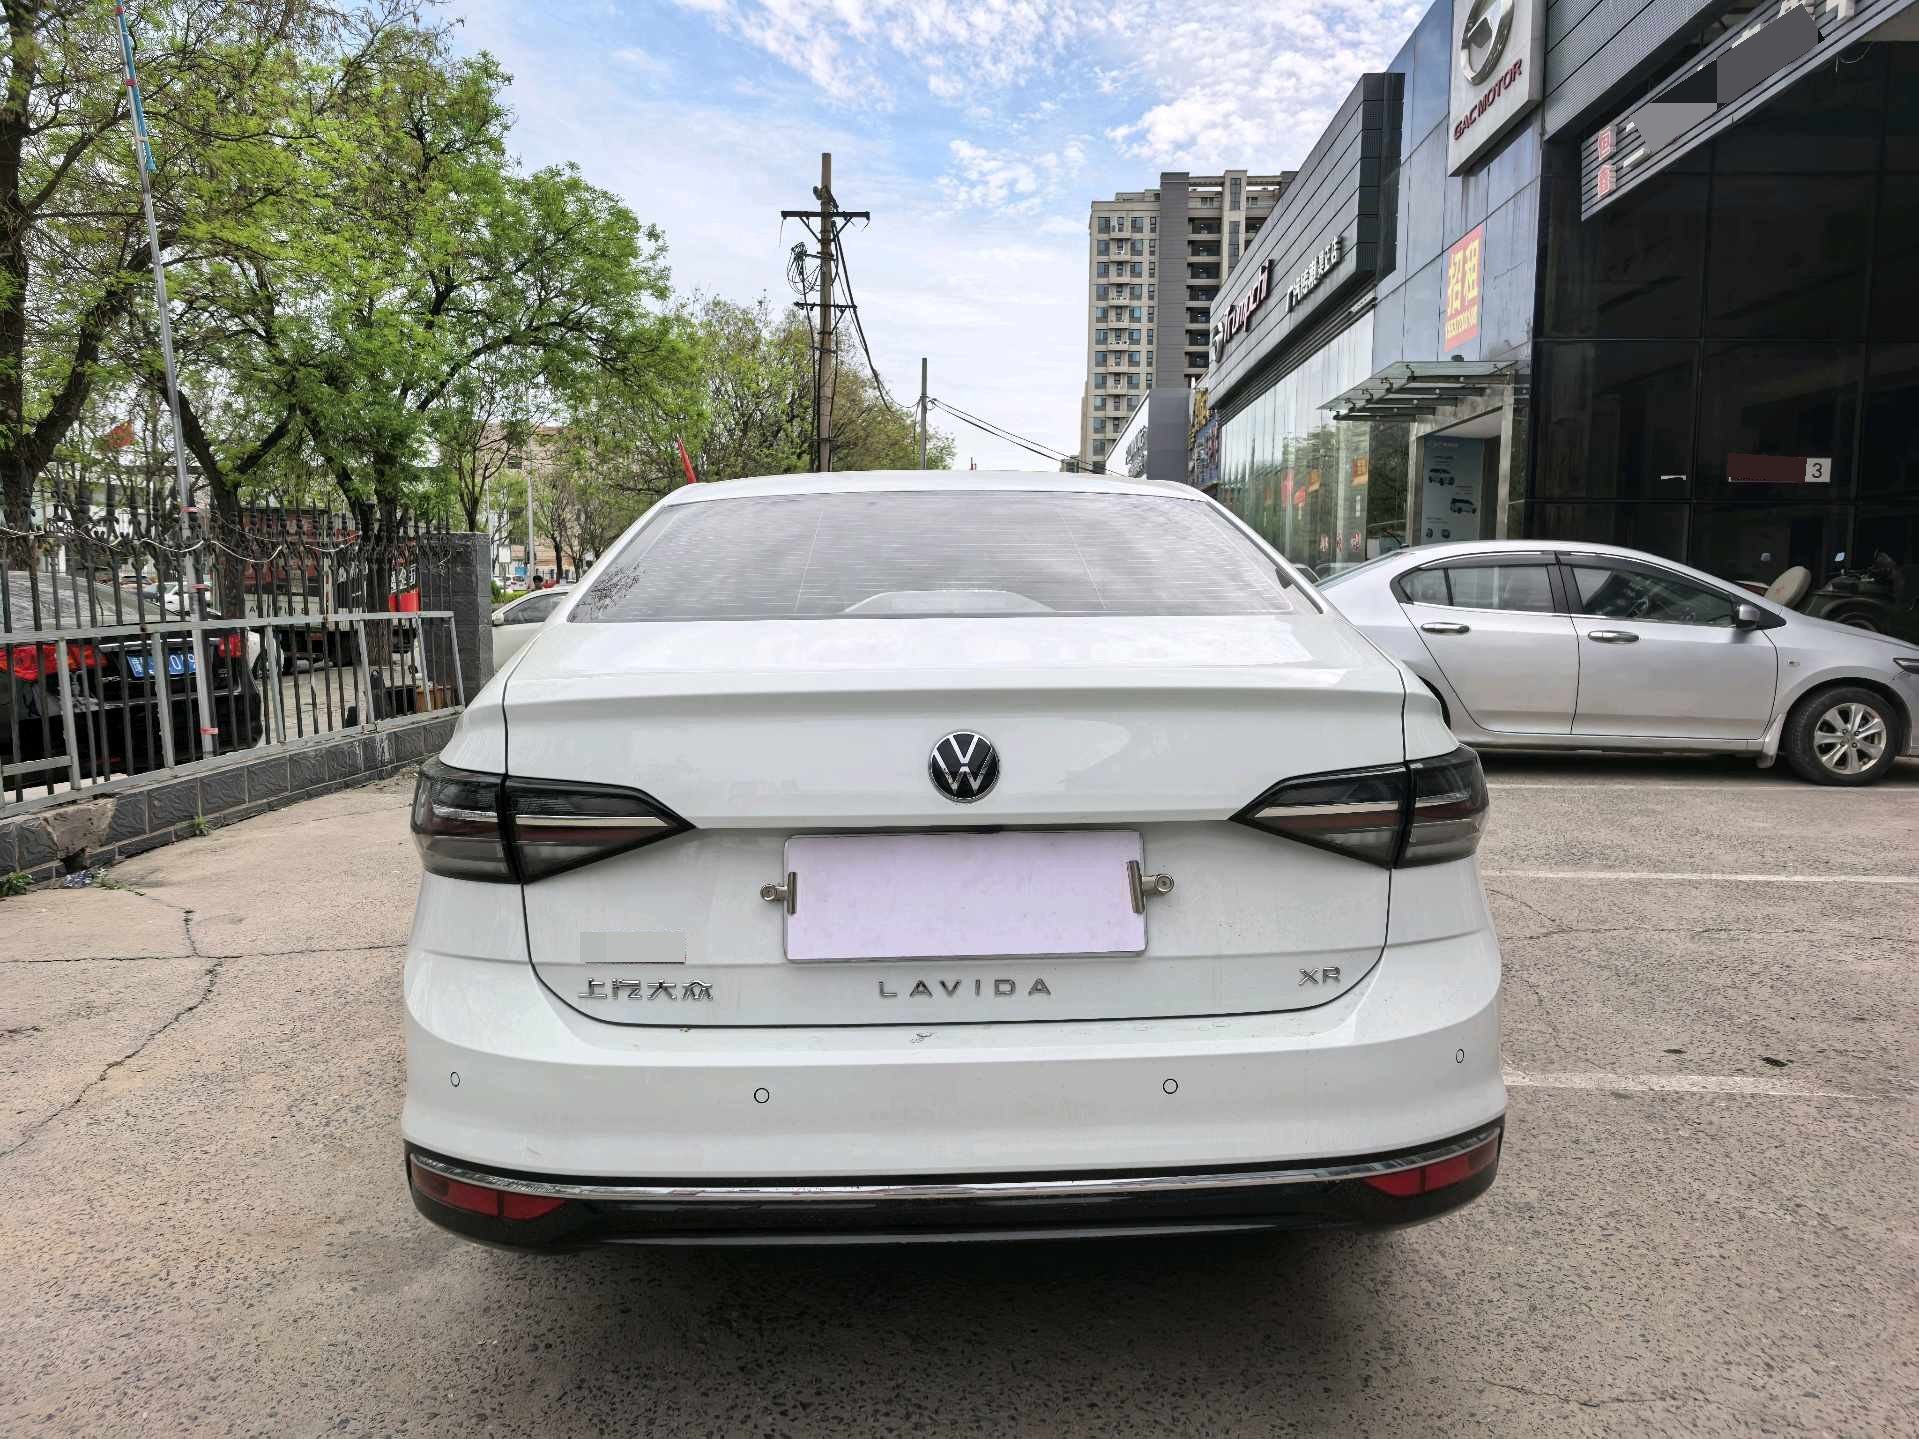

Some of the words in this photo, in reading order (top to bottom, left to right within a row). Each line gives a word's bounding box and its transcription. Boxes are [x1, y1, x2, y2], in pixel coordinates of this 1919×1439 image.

[1454, 104, 1478, 141] GAC
[1478, 58, 1523, 118] MOTOR
[1447, 238, 1480, 317] 招租
[1812, 462, 1823, 479] 3
[1298, 966, 1341, 986] XR
[578, 978, 713, 1000] 上汽大众
[878, 978, 1052, 999] LAVIDA
